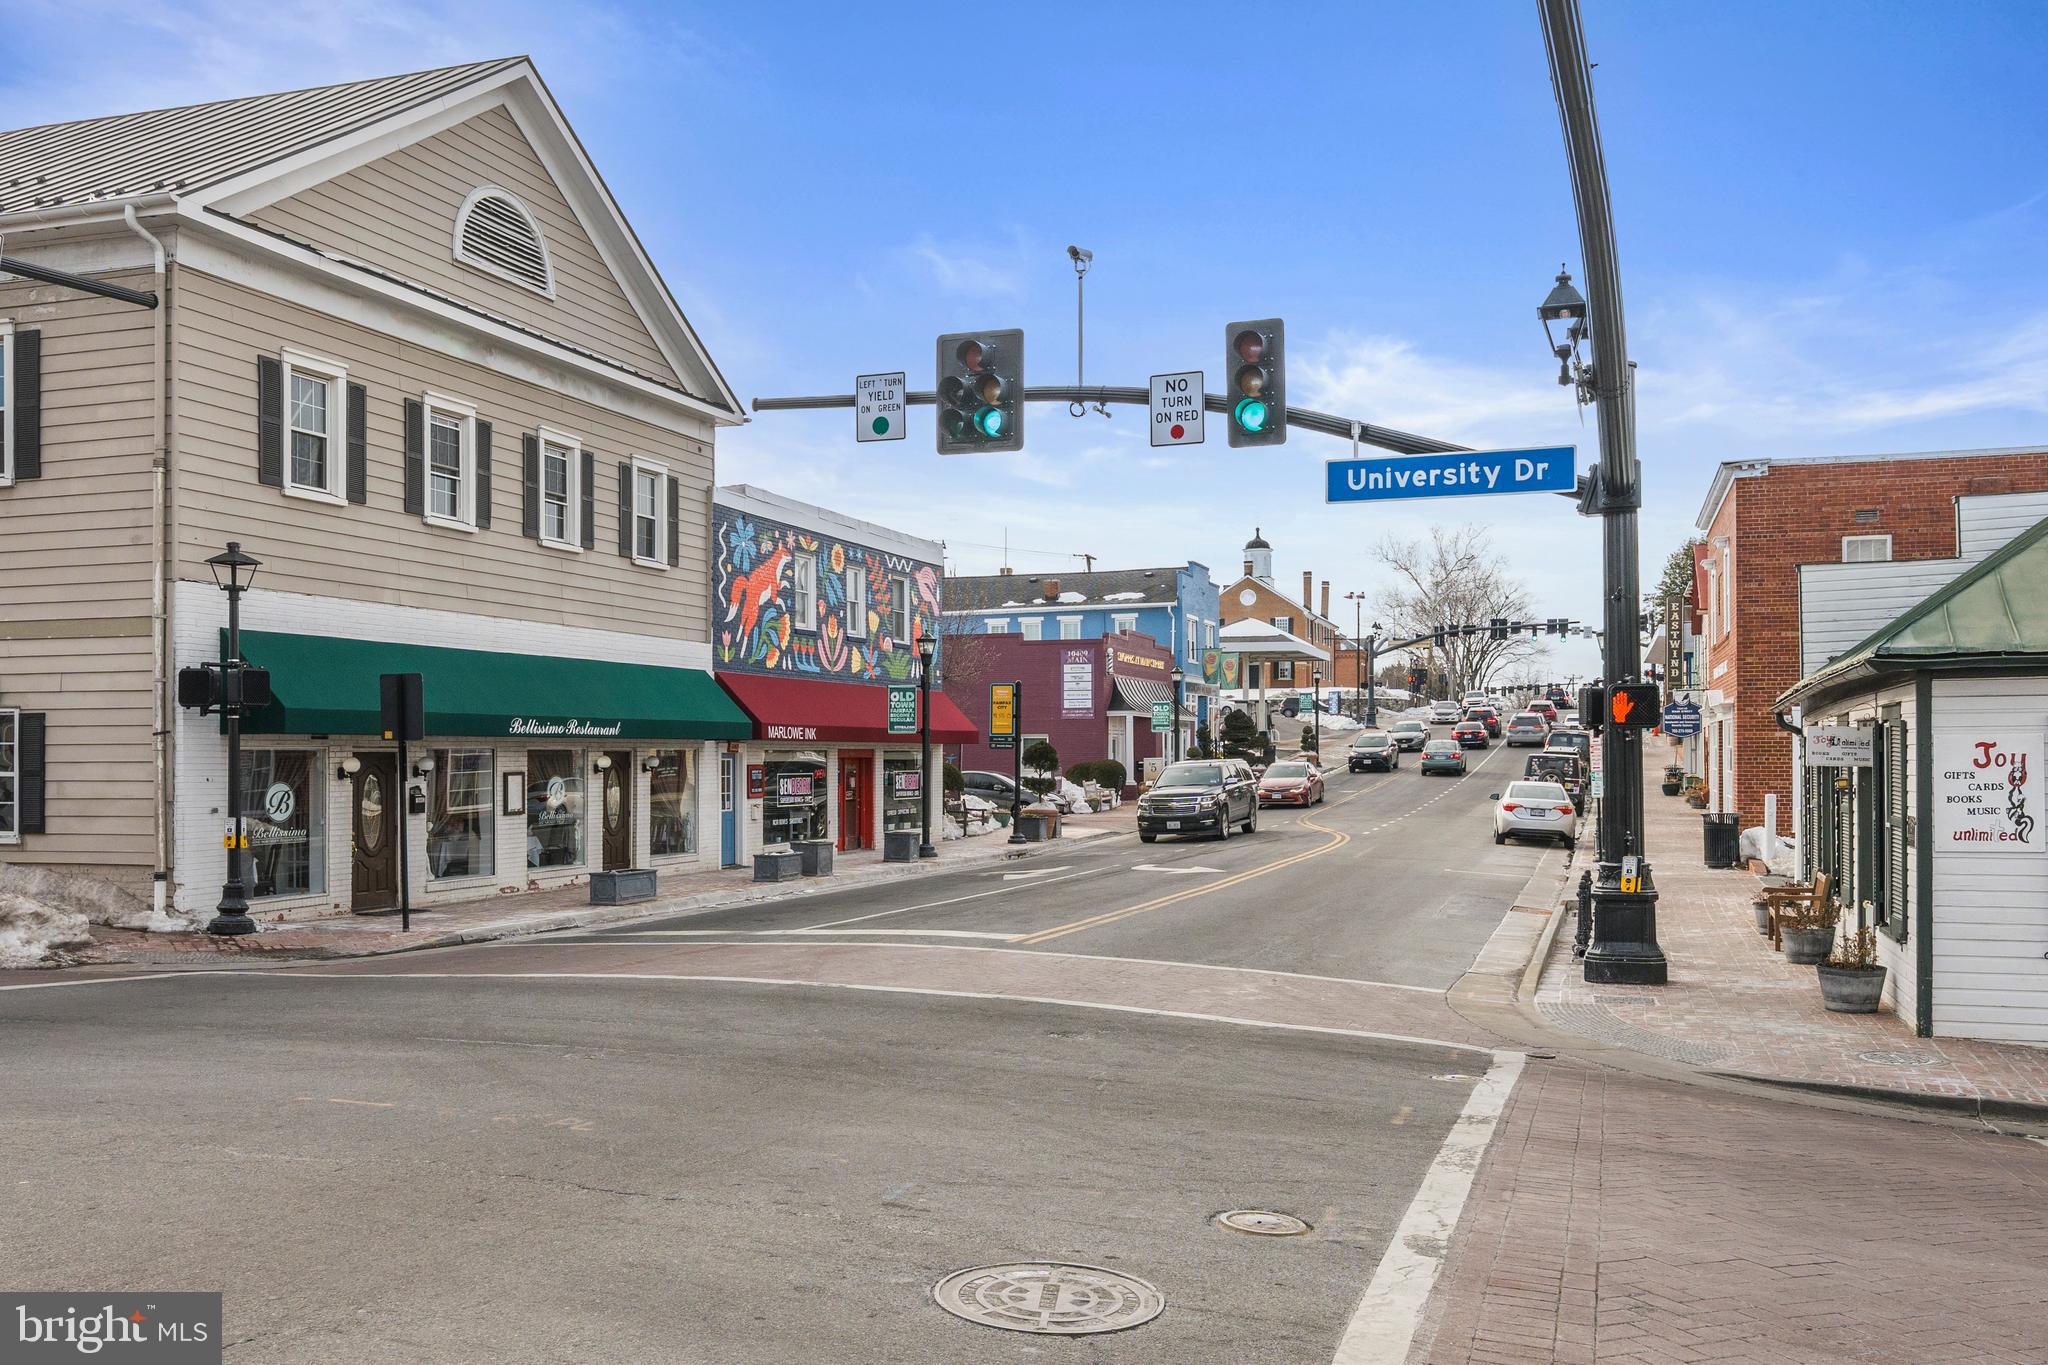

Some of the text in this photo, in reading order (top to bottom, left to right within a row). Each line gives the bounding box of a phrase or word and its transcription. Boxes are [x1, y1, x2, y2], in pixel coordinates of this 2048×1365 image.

[860, 378, 902, 388] LEFT TURN
[1166, 379, 1188, 393] NO
[868, 390, 894, 401] YIELD
[1162, 395, 1192, 408] TURN
[861, 403, 901, 413] ON GREEN
[1156, 410, 1198, 423] ON RED
[1347, 458, 1549, 490] University Dr
[1670, 602, 1681, 677] EASTWIND
[890, 691, 915, 701] OLD
[509, 717, 621, 735] Bellissimo Restaurant
[768, 725, 817, 740] MARLOWE INK
[1973, 742, 2027, 787] Joy
[1944, 771, 1976, 780] GIFTS
[1968, 783, 2005, 791] CARDS
[267, 789, 291, 814] B
[1946, 795, 1983, 803] BOOKS
[1967, 807, 2001, 815] MUSIC
[252, 826, 307, 839] Bellissimo
[1953, 819, 2018, 842] unlimited
